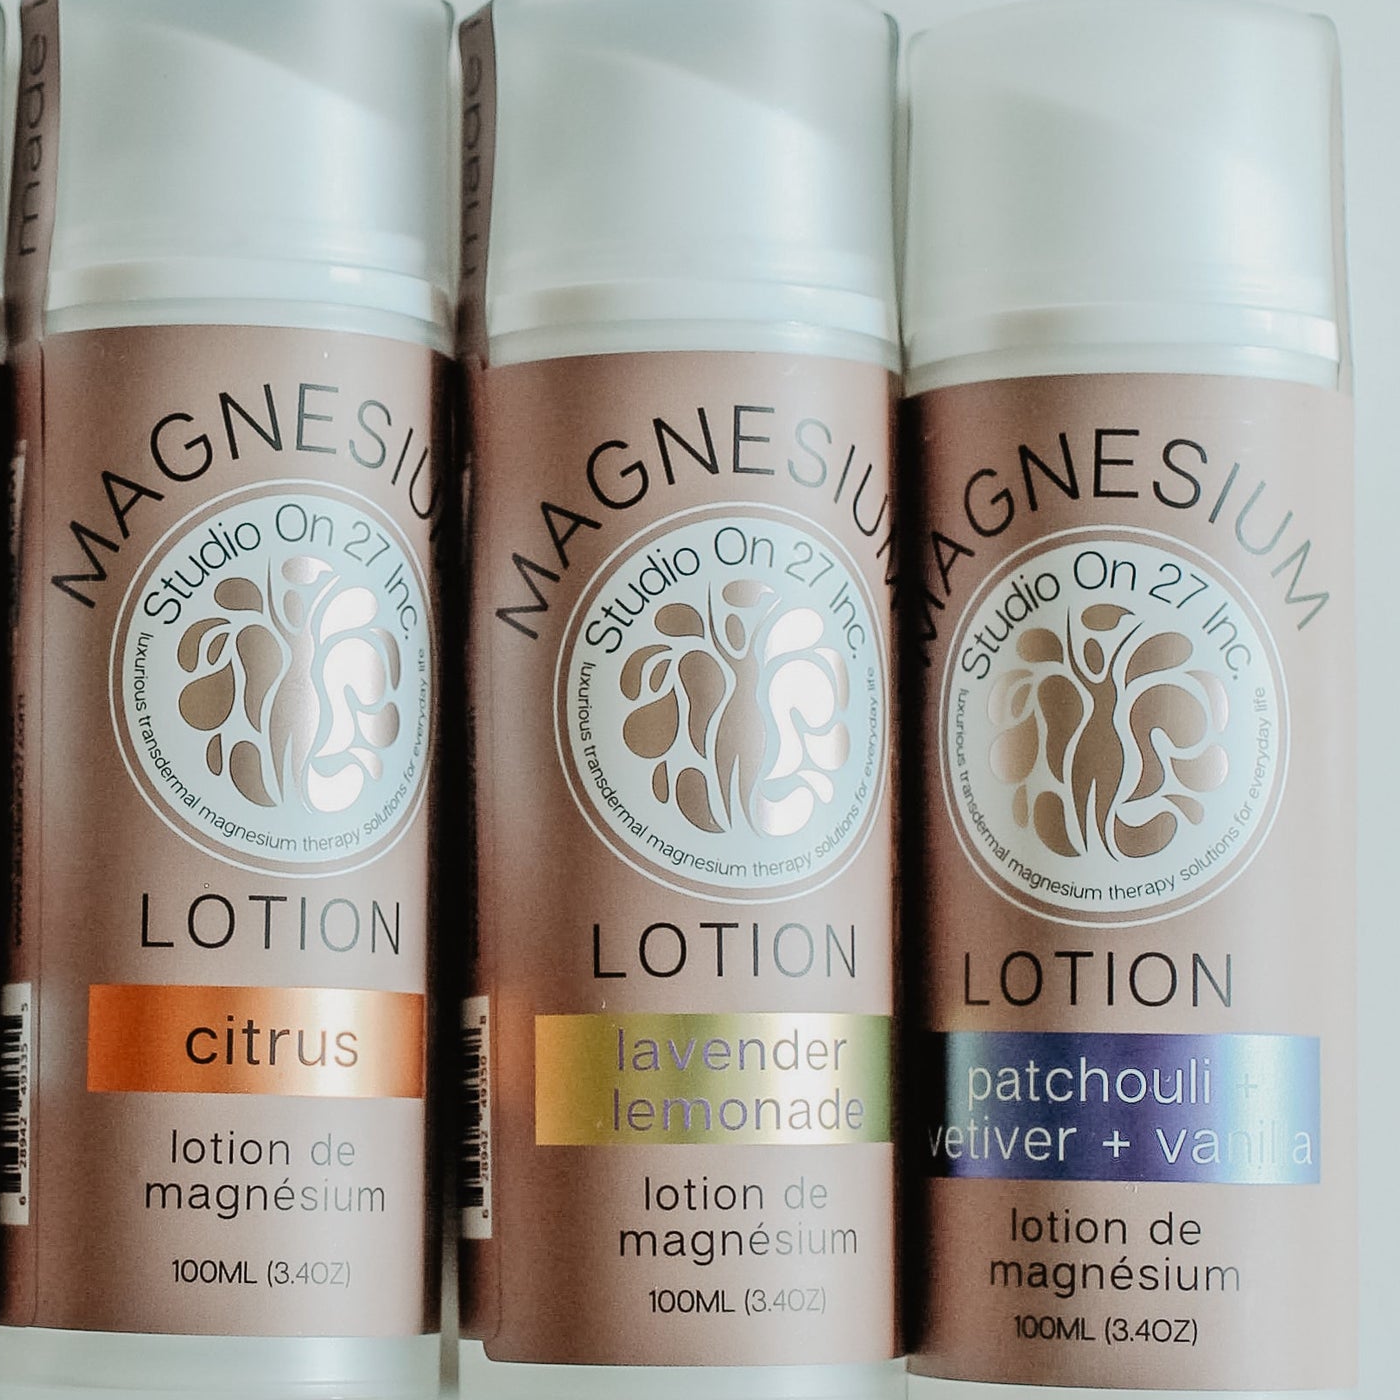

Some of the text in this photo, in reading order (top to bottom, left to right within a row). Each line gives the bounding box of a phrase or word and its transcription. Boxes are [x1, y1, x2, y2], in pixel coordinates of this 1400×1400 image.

[51, 382, 442, 610] MAGNESIU
[143, 503, 418, 640] Studio On 27 Inc.
[585, 526, 865, 659] Studio On 27 Inc.
[961, 550, 1252, 680] Studio On 27 Inc.
[133, 631, 154, 710] luxurious
[412, 678, 429, 758] everyday
[578, 661, 597, 740] luxurious
[138, 715, 200, 809] transdermal
[863, 698, 880, 779] everyday
[402, 758, 418, 783] for
[583, 744, 648, 839] transdermal
[855, 781, 870, 806] for
[955, 687, 1272, 900] luxurious transdermal magnesium therapy solutions for everyday life
[199, 804, 297, 852] magnesium
[363, 782, 408, 836] solutions
[814, 804, 860, 859] solutions
[302, 826, 361, 852] therapy
[647, 834, 747, 878] magnesium
[752, 850, 813, 878] therapy
[141, 893, 399, 954] LOTION
[593, 922, 855, 979] LOTION
[964, 951, 1232, 1008] LOTION
[186, 1015, 359, 1067] citrus
[617, 1028, 847, 1071] lavender
[967, 1057, 1212, 1111] patchouli
[613, 1088, 864, 1131] lemonade
[171, 1129, 355, 1166] lotion de
[929, 1116, 1077, 1162] vetiver
[1155, 1119, 1313, 1165] vanilla
[145, 1178, 385, 1219] magnésium
[644, 1177, 827, 1211] lotion de
[619, 1222, 857, 1266] magnésium
[1011, 1207, 1201, 1245] lotion de
[172, 1259, 257, 1284] 100ML
[990, 1256, 1240, 1298] magnésium
[648, 1289, 735, 1314] 100ML
[1014, 1315, 1095, 1341] 100ML
